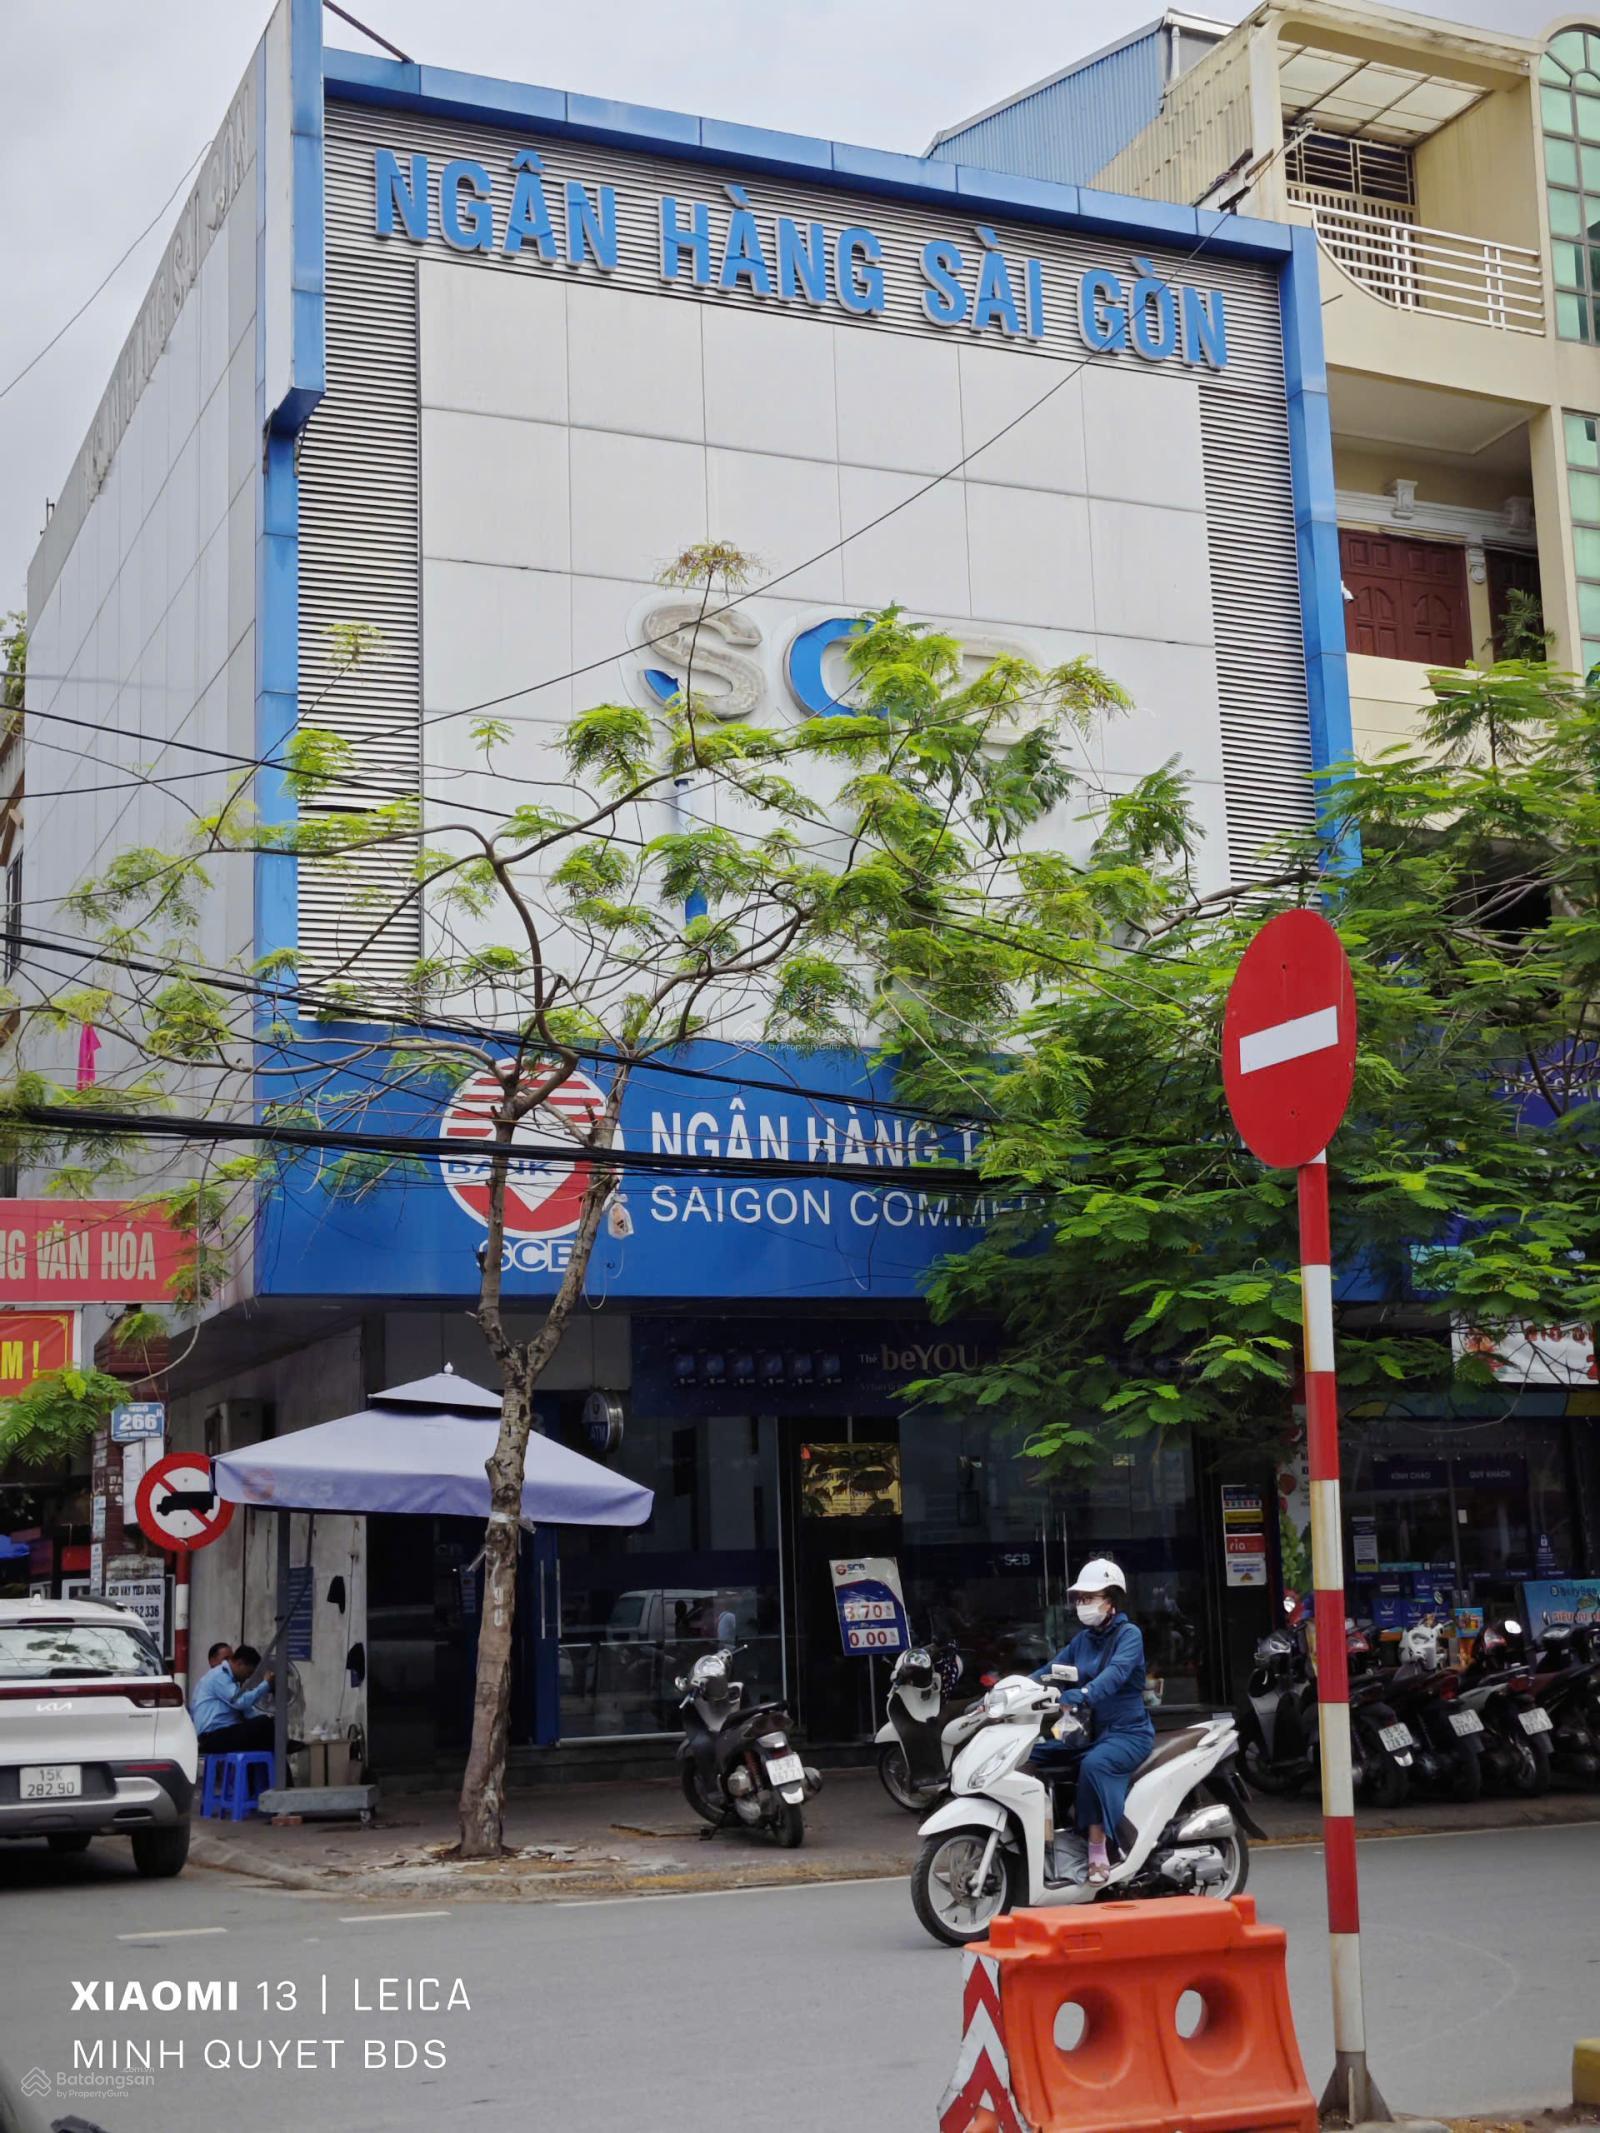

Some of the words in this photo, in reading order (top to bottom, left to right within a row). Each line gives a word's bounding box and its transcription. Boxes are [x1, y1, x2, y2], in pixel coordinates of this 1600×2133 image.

[374, 149, 616, 272] NGÂN
[660, 185, 885, 317] HÀNG
[921, 225, 1043, 341] SÀI
[1077, 255, 1228, 371] GÒN
[651, 1098, 789, 1172] NGÂN
[806, 1104, 938, 1174] HÀNG
[650, 1185, 831, 1226] SAIGON
[36, 1220, 89, 1280] VĂN
[100, 1220, 157, 1281] HÓA
[880, 1344, 978, 1371] beYOU
[119, 1413, 158, 1431] 266
[1004, 1553, 1031, 1566] SCB
[39, 1768, 63, 1783] 15K
[27, 1782, 75, 1798] 282.90
